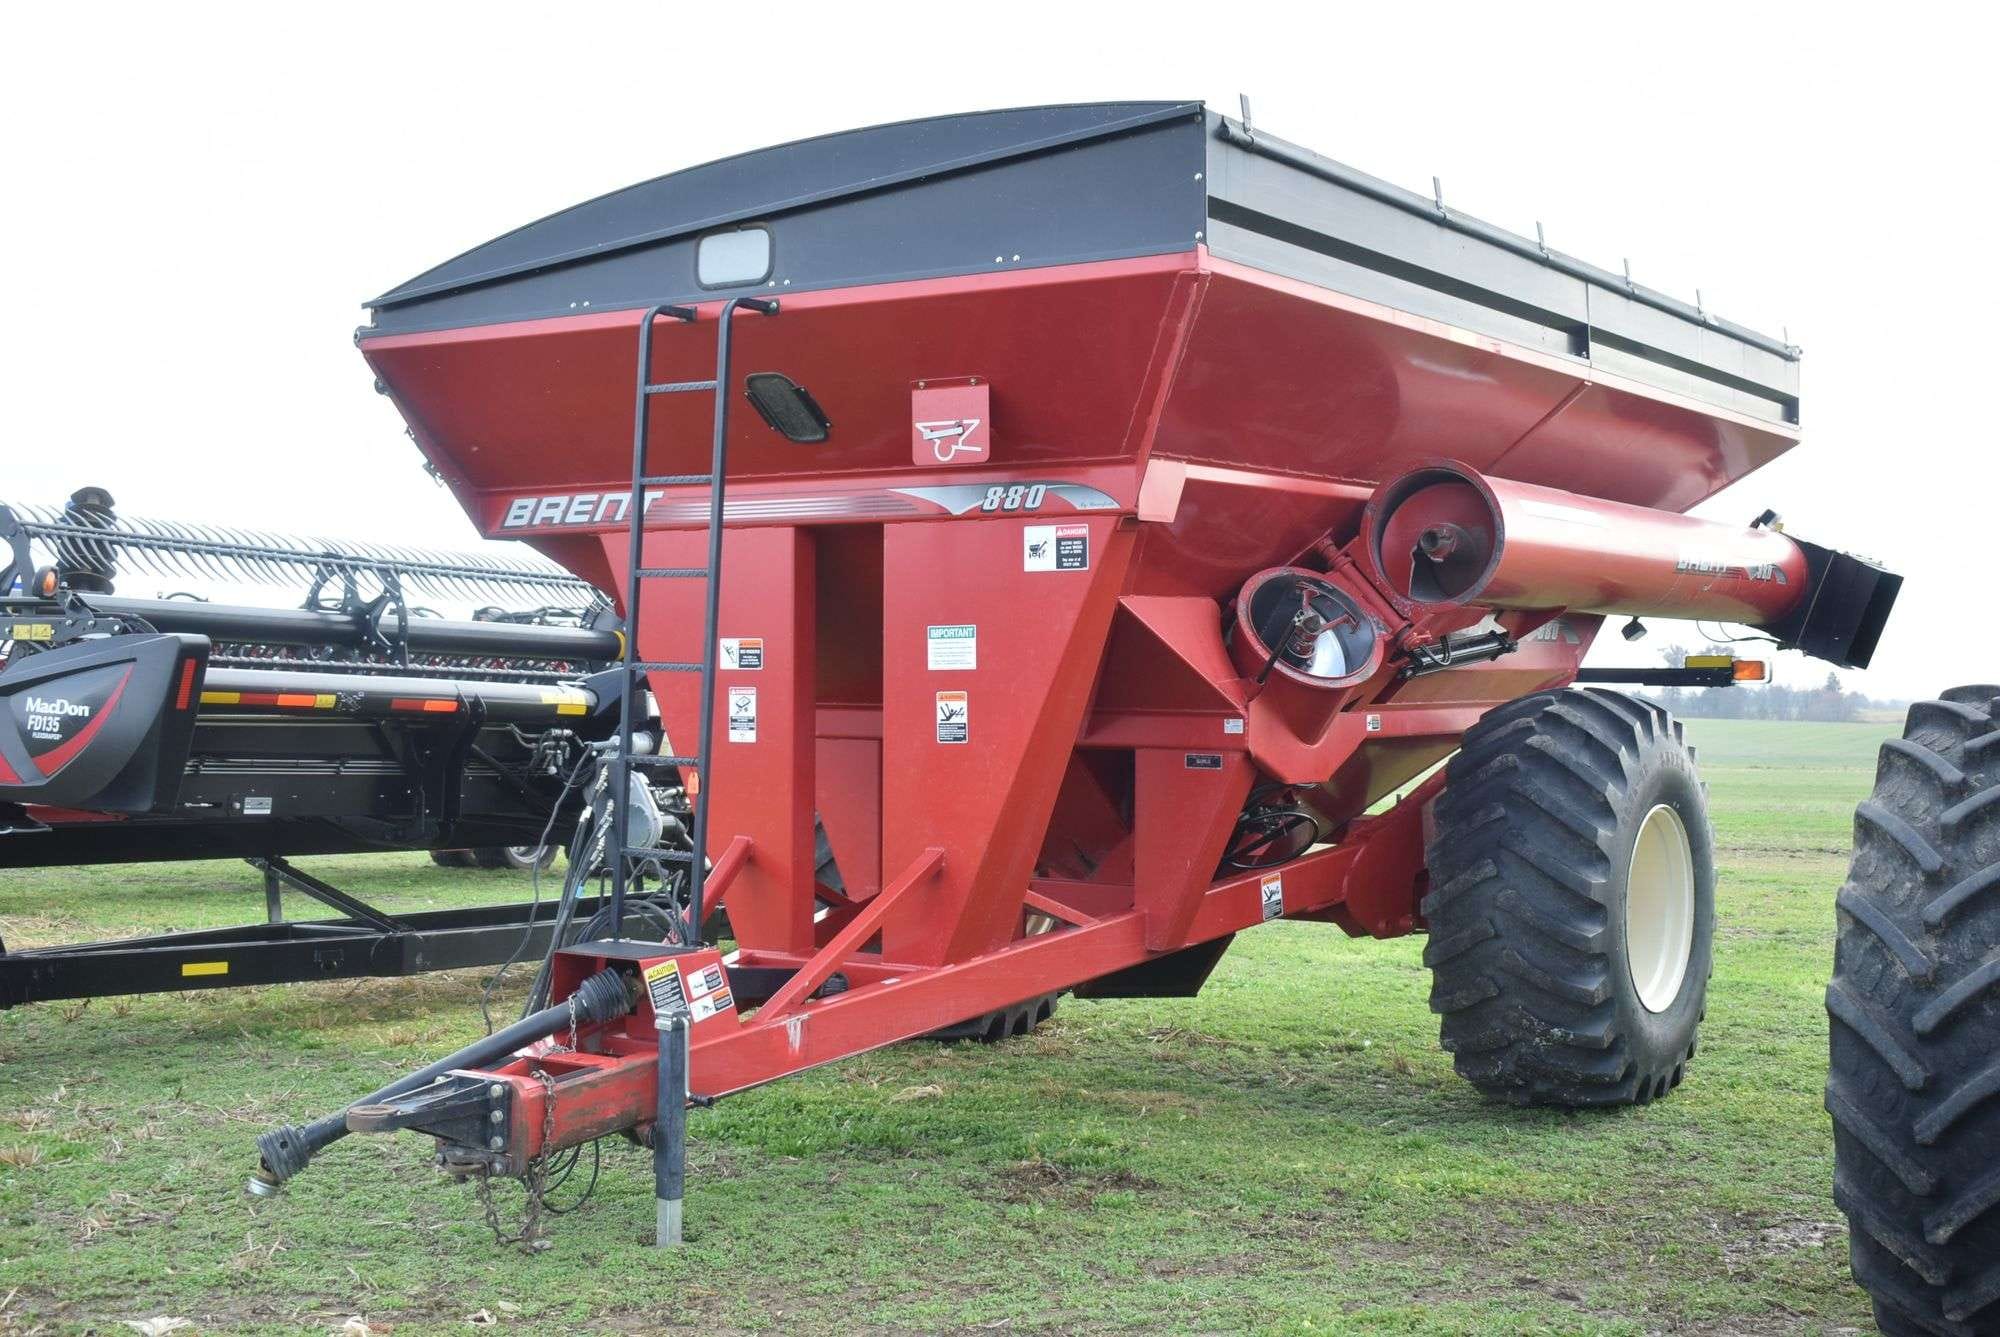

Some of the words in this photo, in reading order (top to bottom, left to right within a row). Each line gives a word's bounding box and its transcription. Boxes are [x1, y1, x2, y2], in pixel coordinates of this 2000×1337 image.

[981, 484, 1047, 512] 880
[503, 490, 665, 528] BRENT
[930, 626, 974, 639] IMPORTANT
[26, 697, 90, 717] MacDon
[27, 715, 61, 732] FD135
[652, 962, 677, 978] CAUTION
